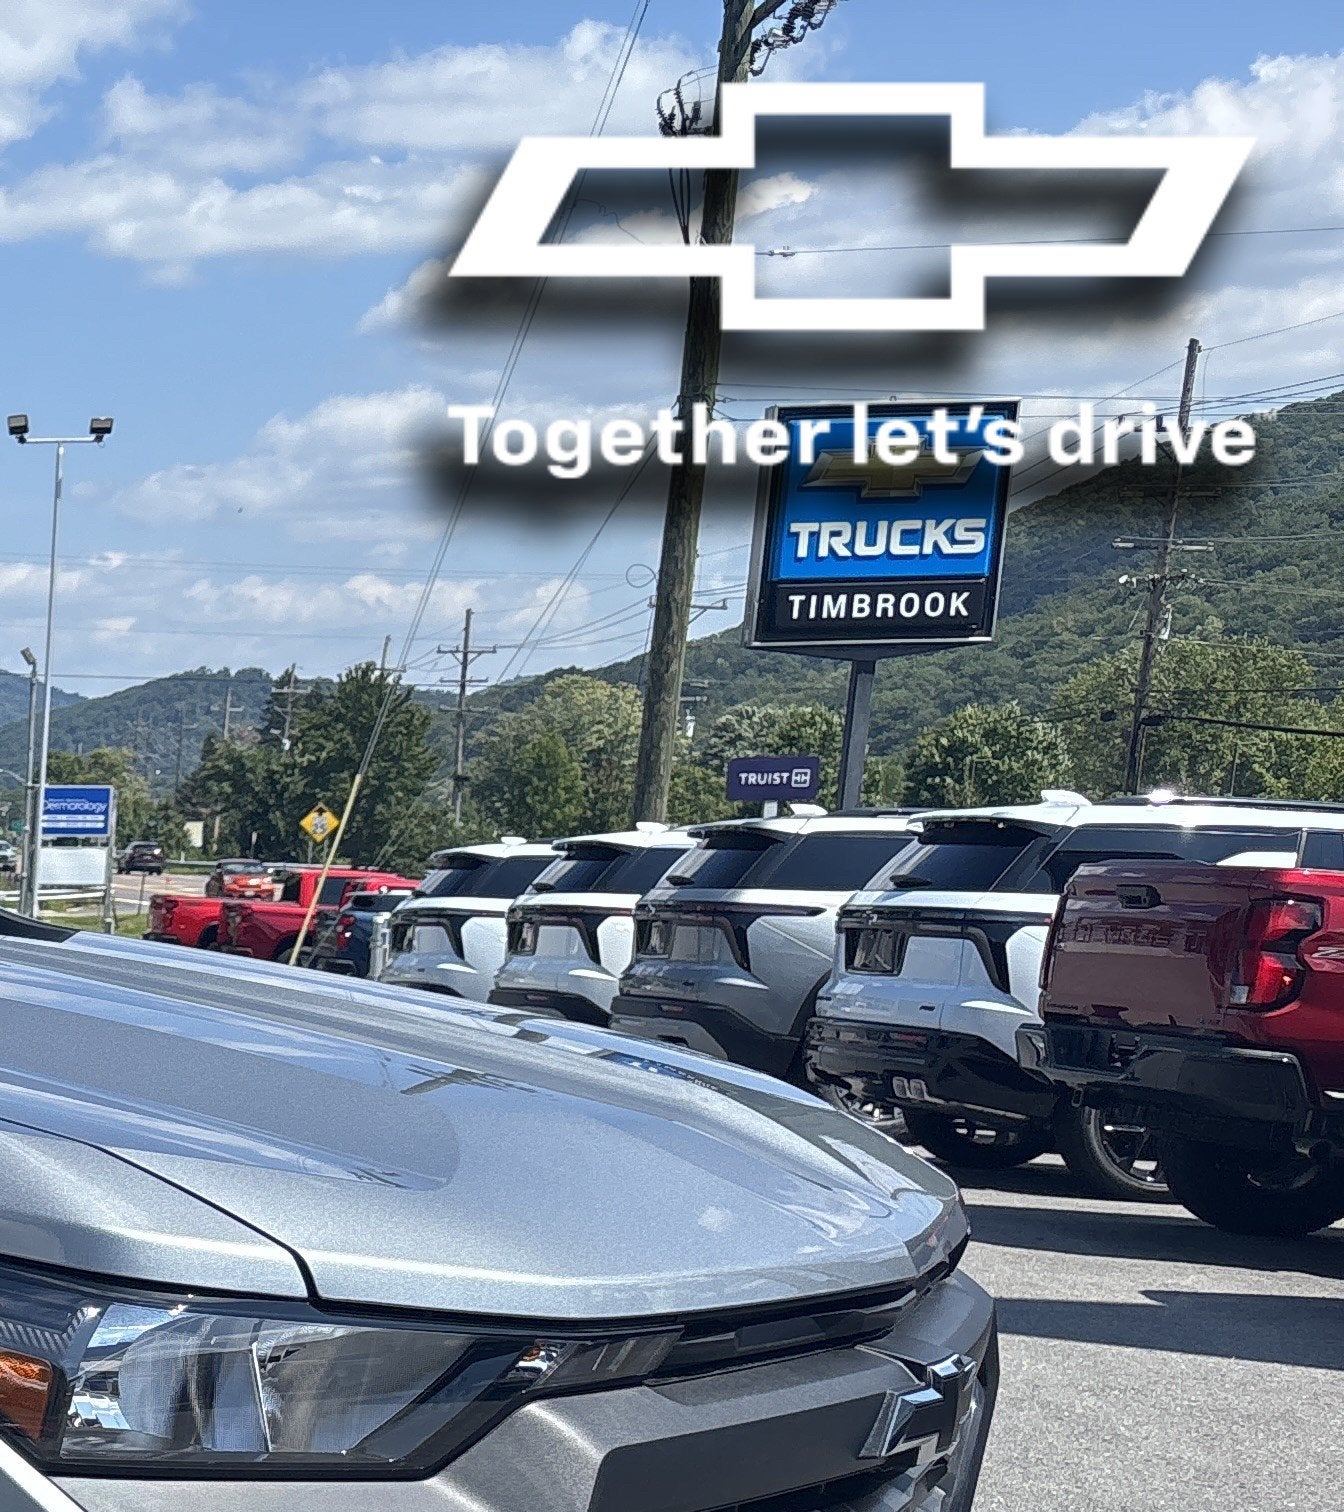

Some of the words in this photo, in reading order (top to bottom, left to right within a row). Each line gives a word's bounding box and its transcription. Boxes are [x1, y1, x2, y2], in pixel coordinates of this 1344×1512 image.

[789, 519, 988, 559] TRUCKS
[788, 591, 972, 621] TIMBROOK
[738, 772, 791, 785] TRUIST
